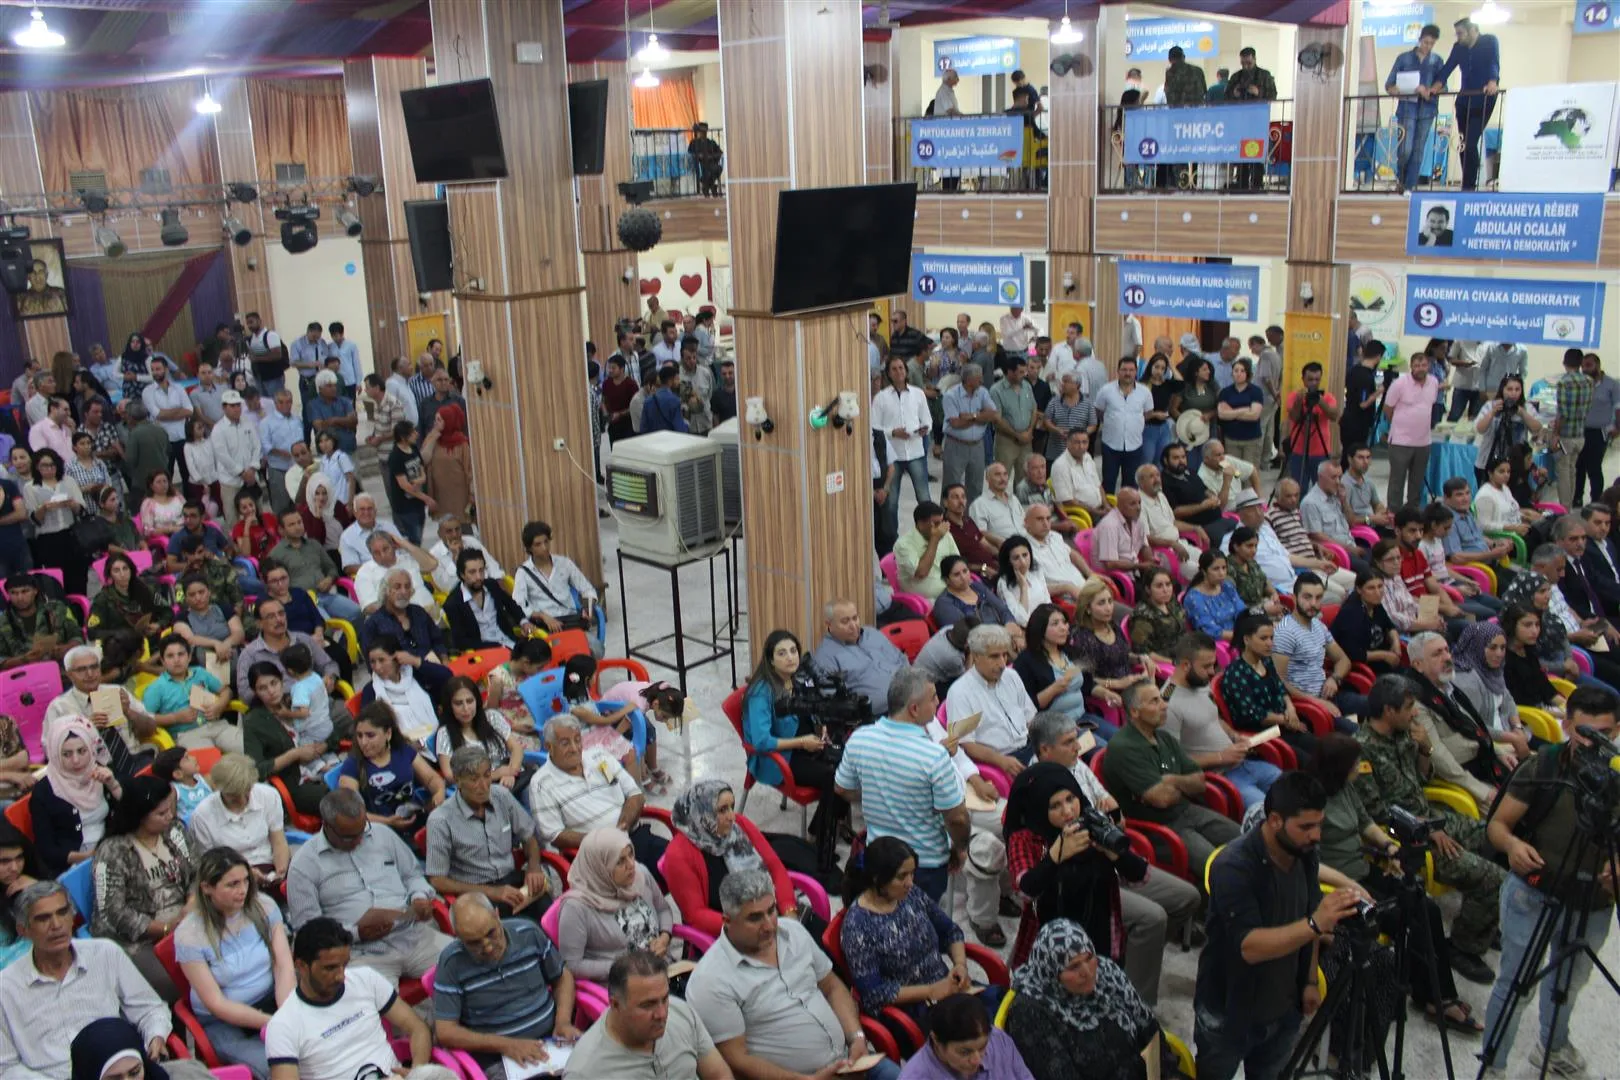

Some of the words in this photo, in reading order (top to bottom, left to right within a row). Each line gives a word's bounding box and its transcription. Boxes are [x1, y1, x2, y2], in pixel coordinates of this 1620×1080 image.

[1586, 6, 1608, 22] 14
[1174, 122, 1225, 140] THKP-C
[919, 143, 932, 156] 20
[1141, 142, 1156, 154] 21
[1474, 222, 1520, 236] ABDULAH
[1524, 222, 1566, 236] OCALAN
[920, 278, 934, 292] 11
[1125, 288, 1144, 304] 10
[1414, 286, 1469, 302] AKADEMIYA
[1472, 290, 1509, 304] CIVAKA
[1420, 304, 1438, 326] 9
